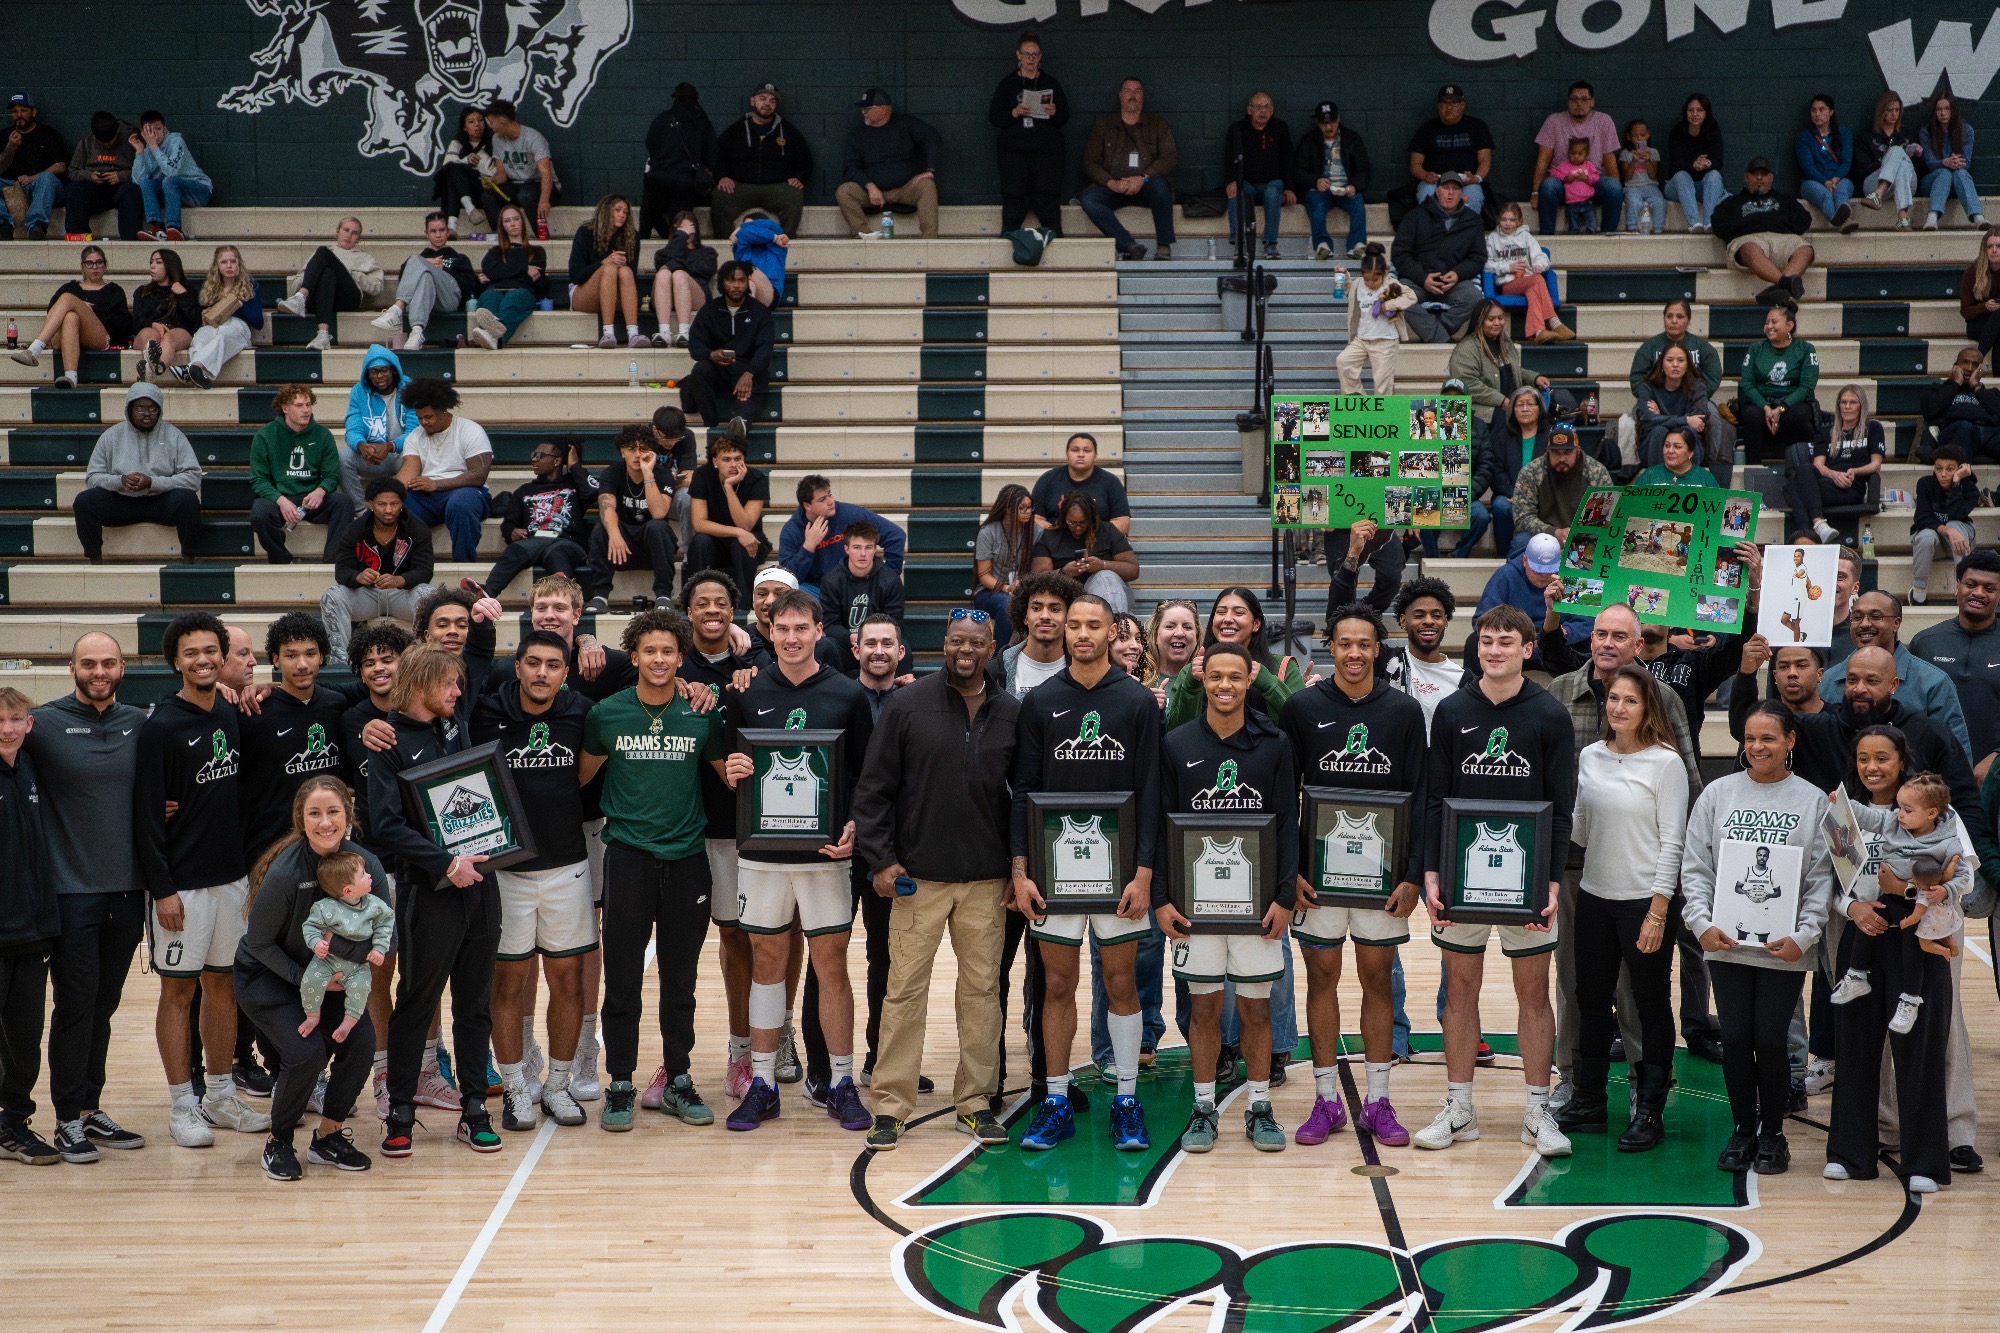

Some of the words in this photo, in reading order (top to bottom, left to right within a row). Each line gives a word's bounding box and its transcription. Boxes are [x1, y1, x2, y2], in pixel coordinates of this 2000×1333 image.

[1333, 397, 1385, 412] LUKE
[1332, 424, 1399, 439] SENIOR
[1621, 486, 1671, 498] Senior
[1598, 506, 1624, 579] LUKE
[615, 735, 661, 751] ADAMS
[663, 735, 697, 753] STATE
[626, 752, 686, 760] BASKETBALL
[1054, 749, 1125, 761] GRIZZLIES
[1319, 760, 1391, 775] GRIZZLIES
[1461, 763, 1531, 777] GRIZZLIES
[771, 773, 791, 782] Adams
[784, 783, 794, 796] 4
[1191, 798, 1263, 810] GRIZZLIES
[441, 800, 496, 834] GRIZZLIES
[1721, 809, 1801, 830] ADAMS
[1064, 837, 1083, 845] Adams
[1336, 831, 1357, 840] Adams
[1726, 827, 1790, 845] STATE
[1073, 845, 1091, 860] 24
[1346, 840, 1363, 855] 22
[1477, 844, 1497, 853] Adams
[1204, 857, 1224, 865] Adams
[1487, 854, 1503, 868] 12
[1214, 866, 1231, 880] 20
